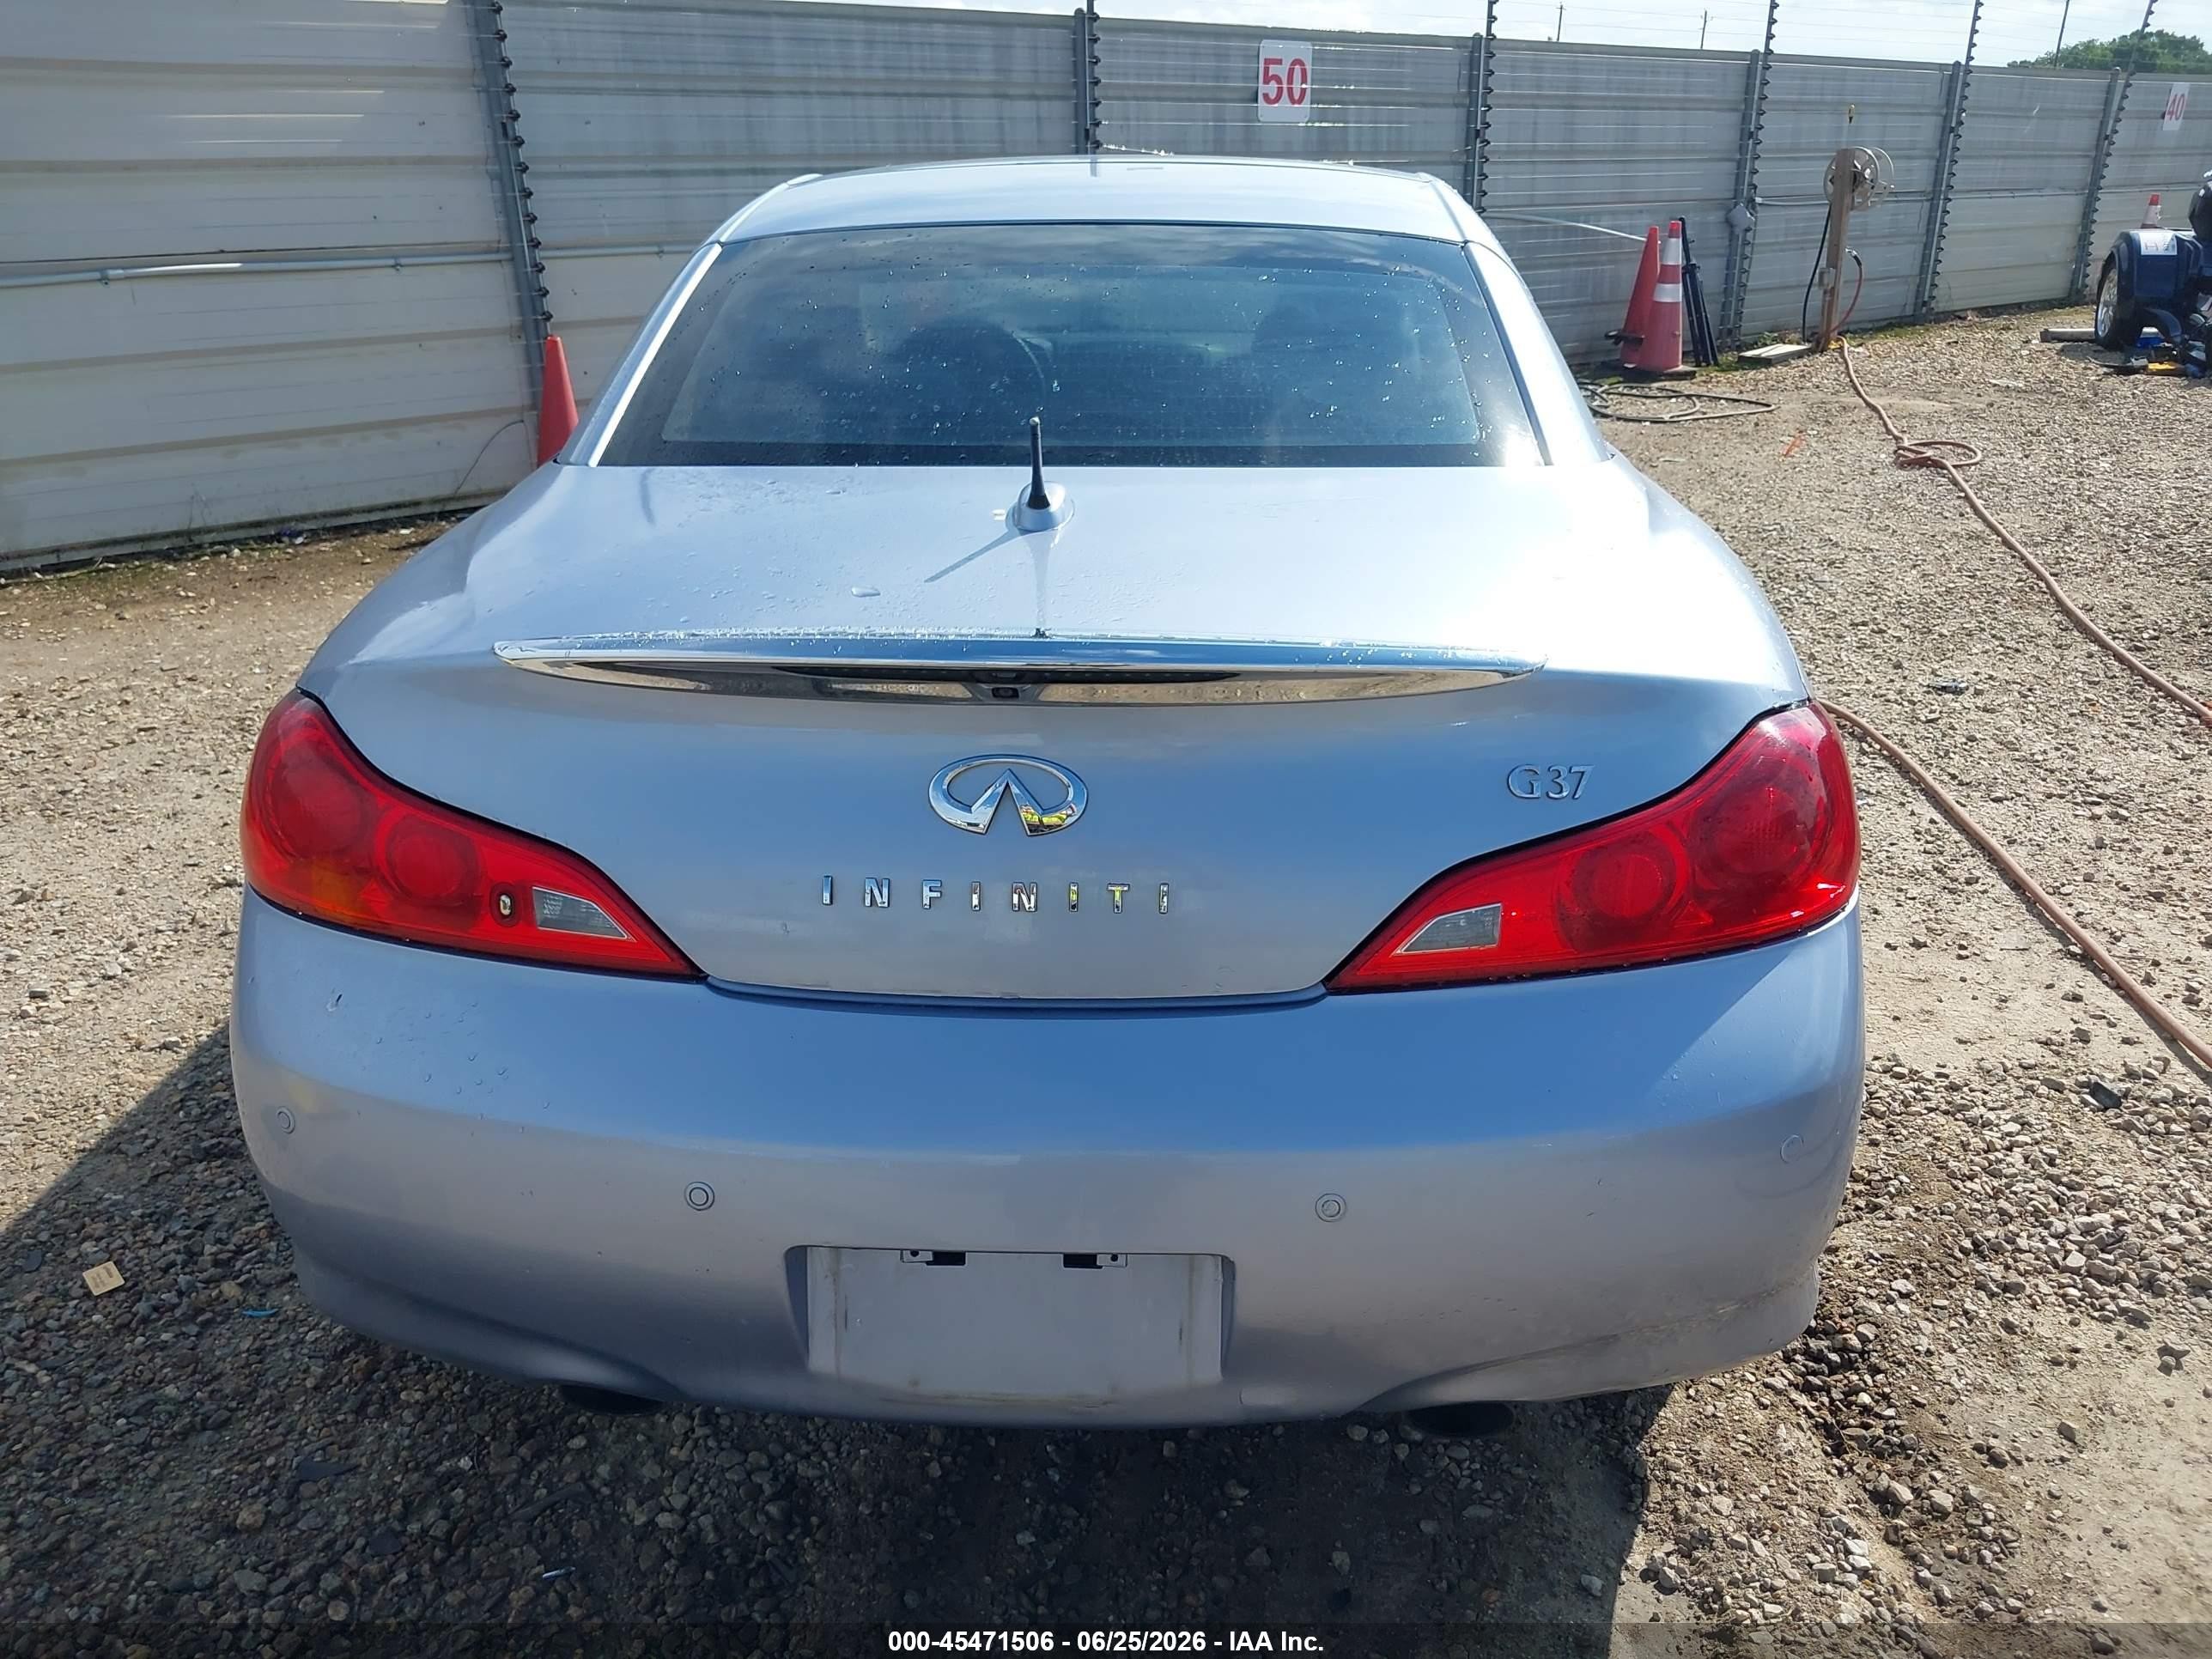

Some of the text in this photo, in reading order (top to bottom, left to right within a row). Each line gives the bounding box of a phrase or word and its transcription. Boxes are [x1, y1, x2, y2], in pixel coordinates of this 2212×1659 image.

[1261, 58, 1309, 105] 50
[2166, 94, 2185, 121] 40
[1507, 764, 1595, 799] G37
[821, 875, 1170, 915] INFINITI
